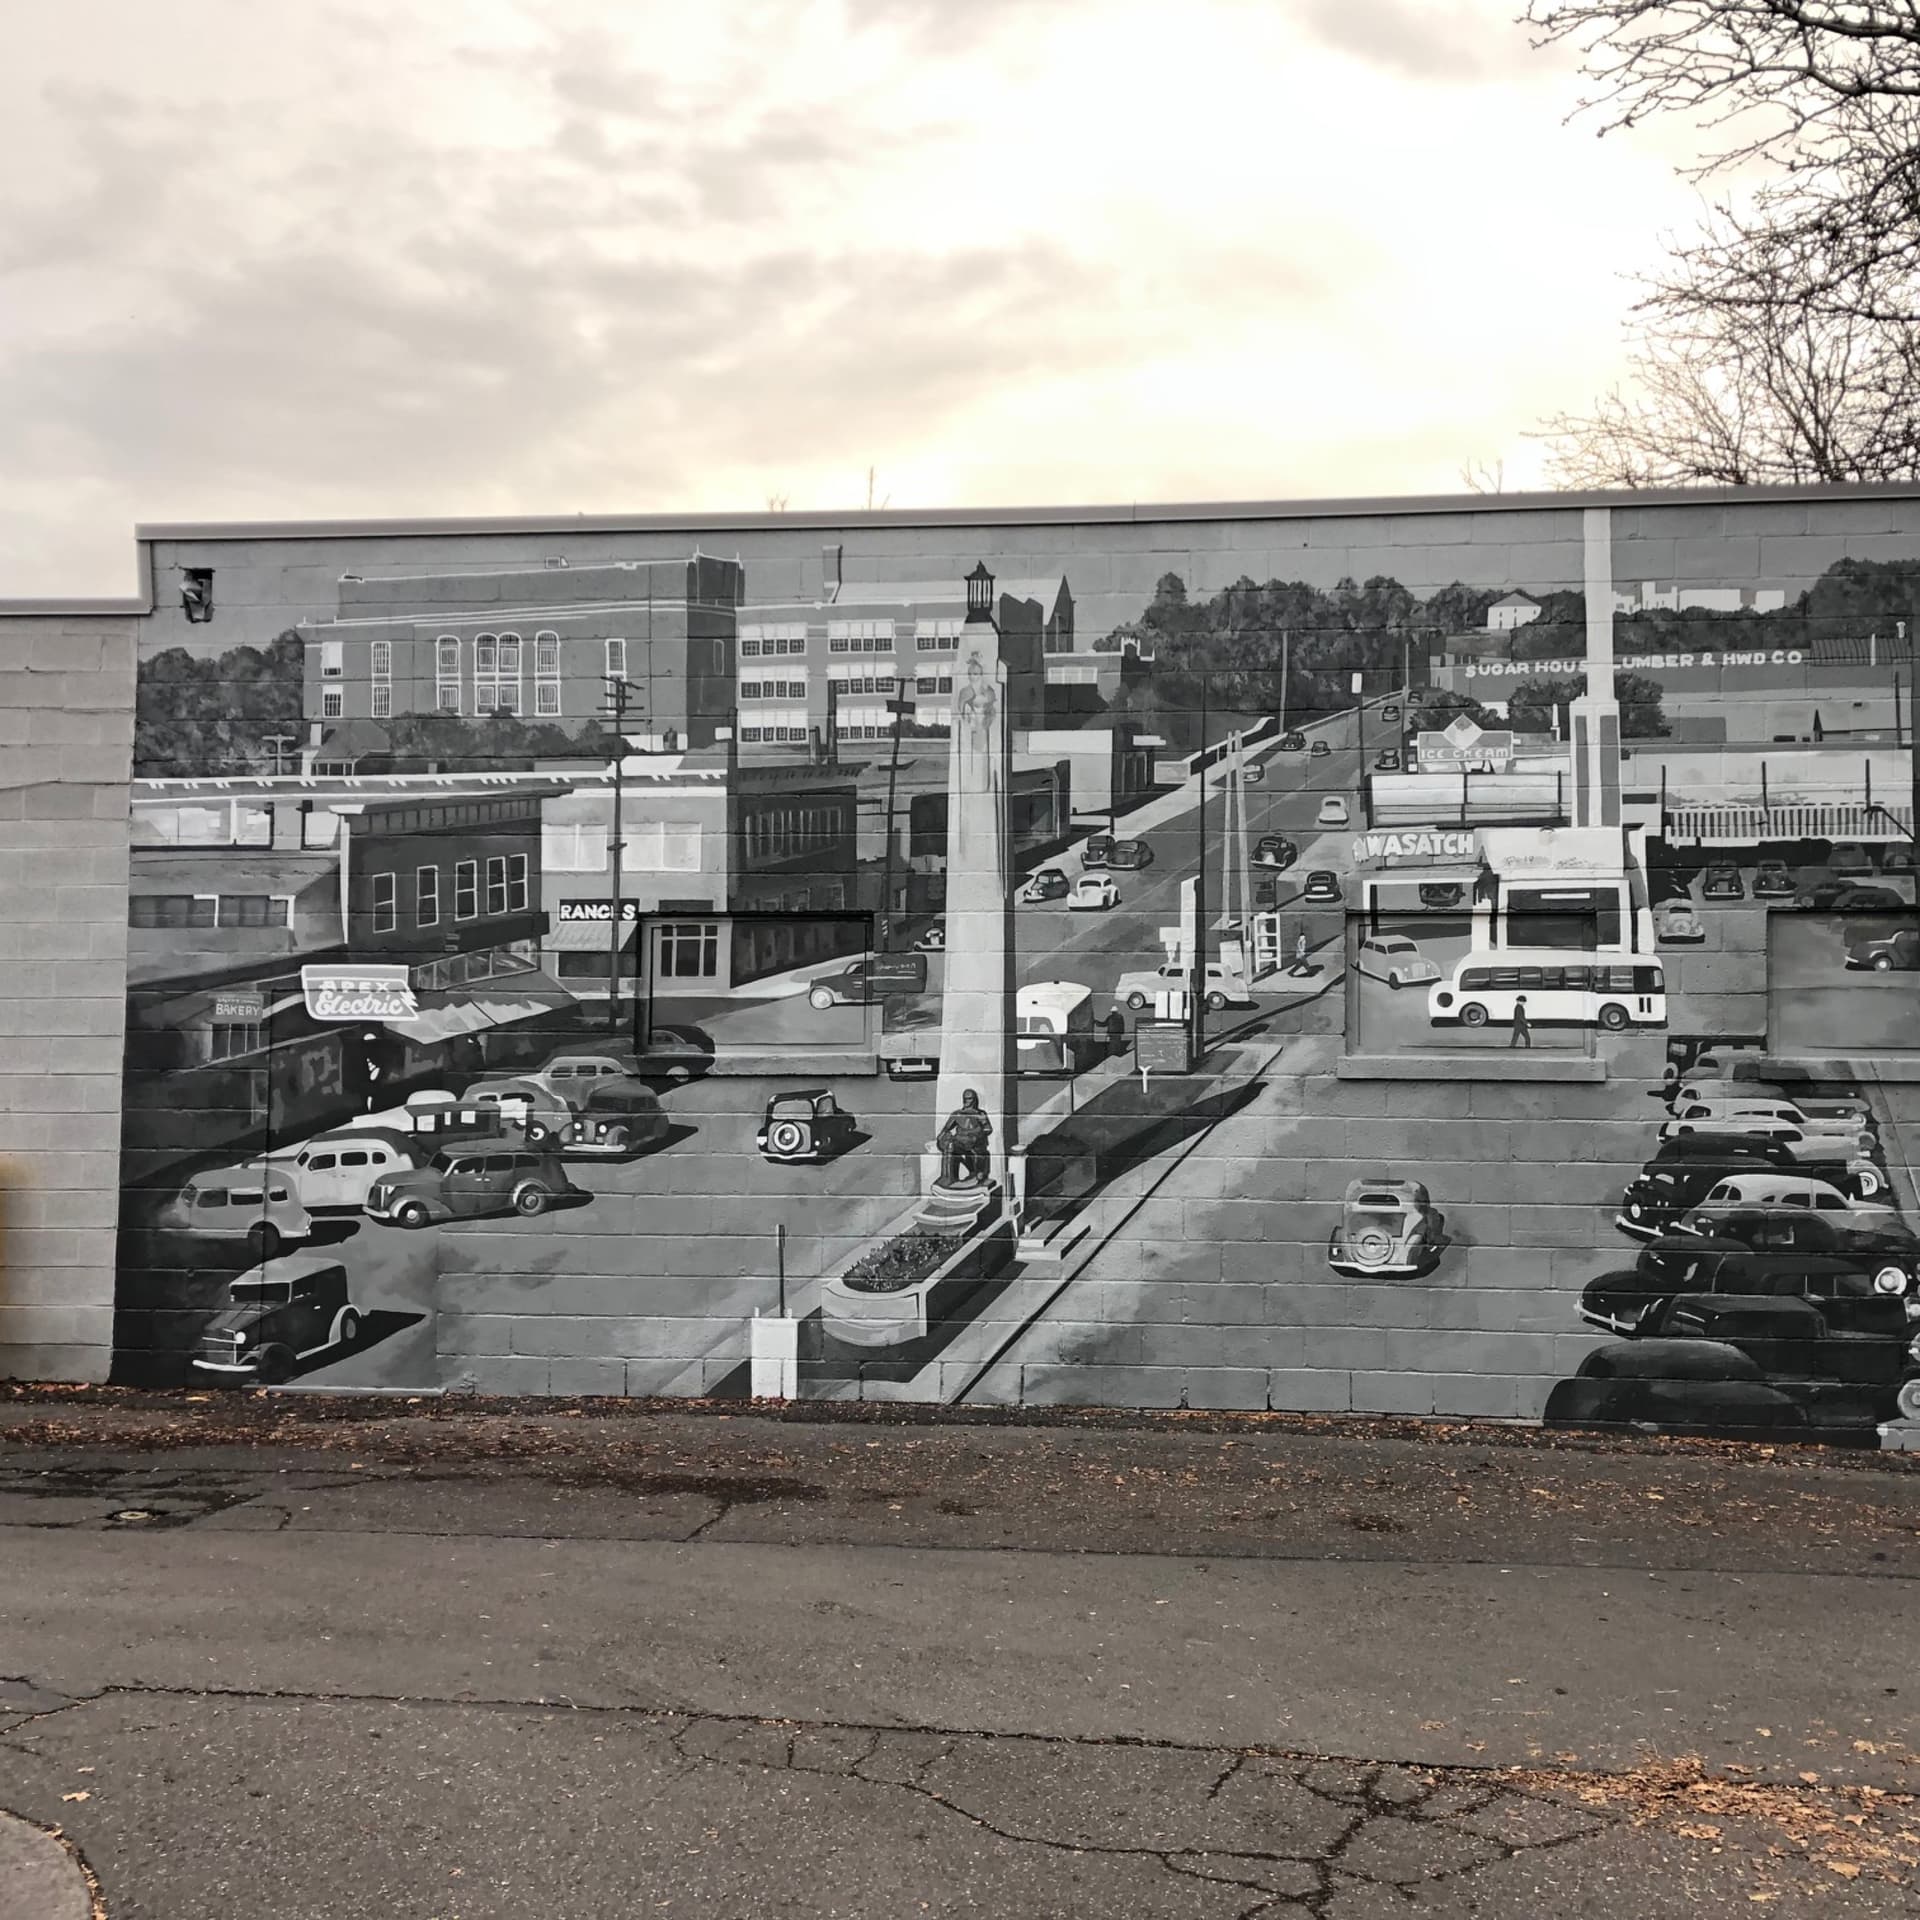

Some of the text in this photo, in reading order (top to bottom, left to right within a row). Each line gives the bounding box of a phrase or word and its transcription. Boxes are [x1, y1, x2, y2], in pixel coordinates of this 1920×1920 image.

[1465, 661, 1530, 678] SUGAR
[1535, 659, 1588, 673] HOUS
[1701, 652, 1715, 666] &
[1723, 653, 1766, 665] HWD
[1771, 650, 1802, 664] CO
[1421, 747, 1508, 759] ICE CREAM
[1366, 833, 1475, 857] WASATCH
[560, 904, 636, 920] RANCS
[319, 981, 390, 993] APEX
[216, 1003, 260, 1016] BAKERY
[315, 991, 403, 1015] Electric
